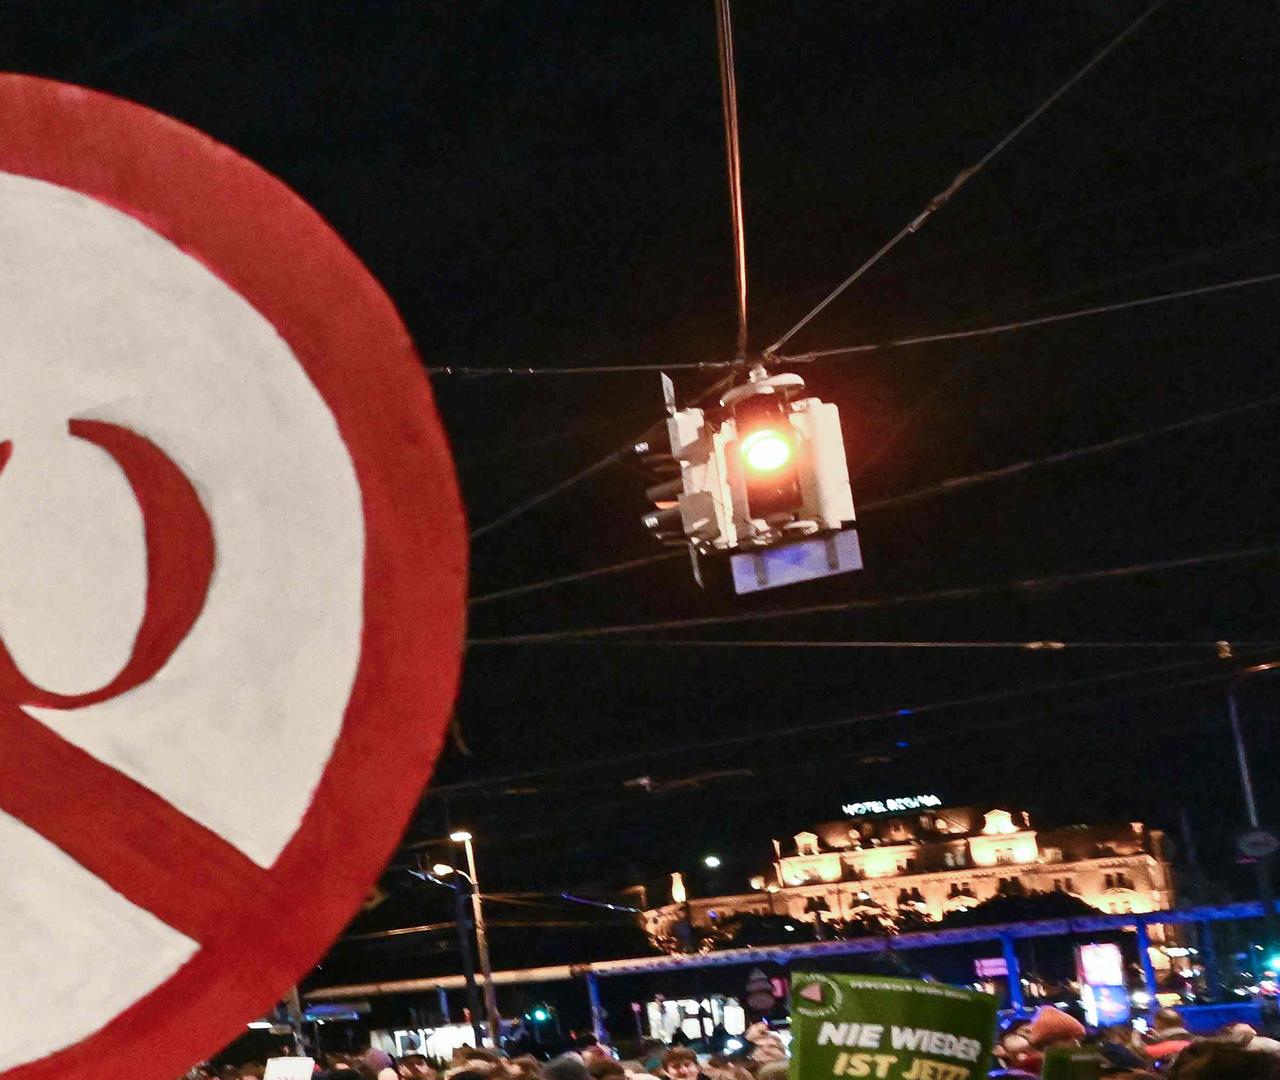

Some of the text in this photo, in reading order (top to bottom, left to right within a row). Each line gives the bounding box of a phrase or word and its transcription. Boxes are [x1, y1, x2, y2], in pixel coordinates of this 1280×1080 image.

[816, 1021, 982, 1063] NIE WIEDER
[833, 1053, 899, 1079] IST
